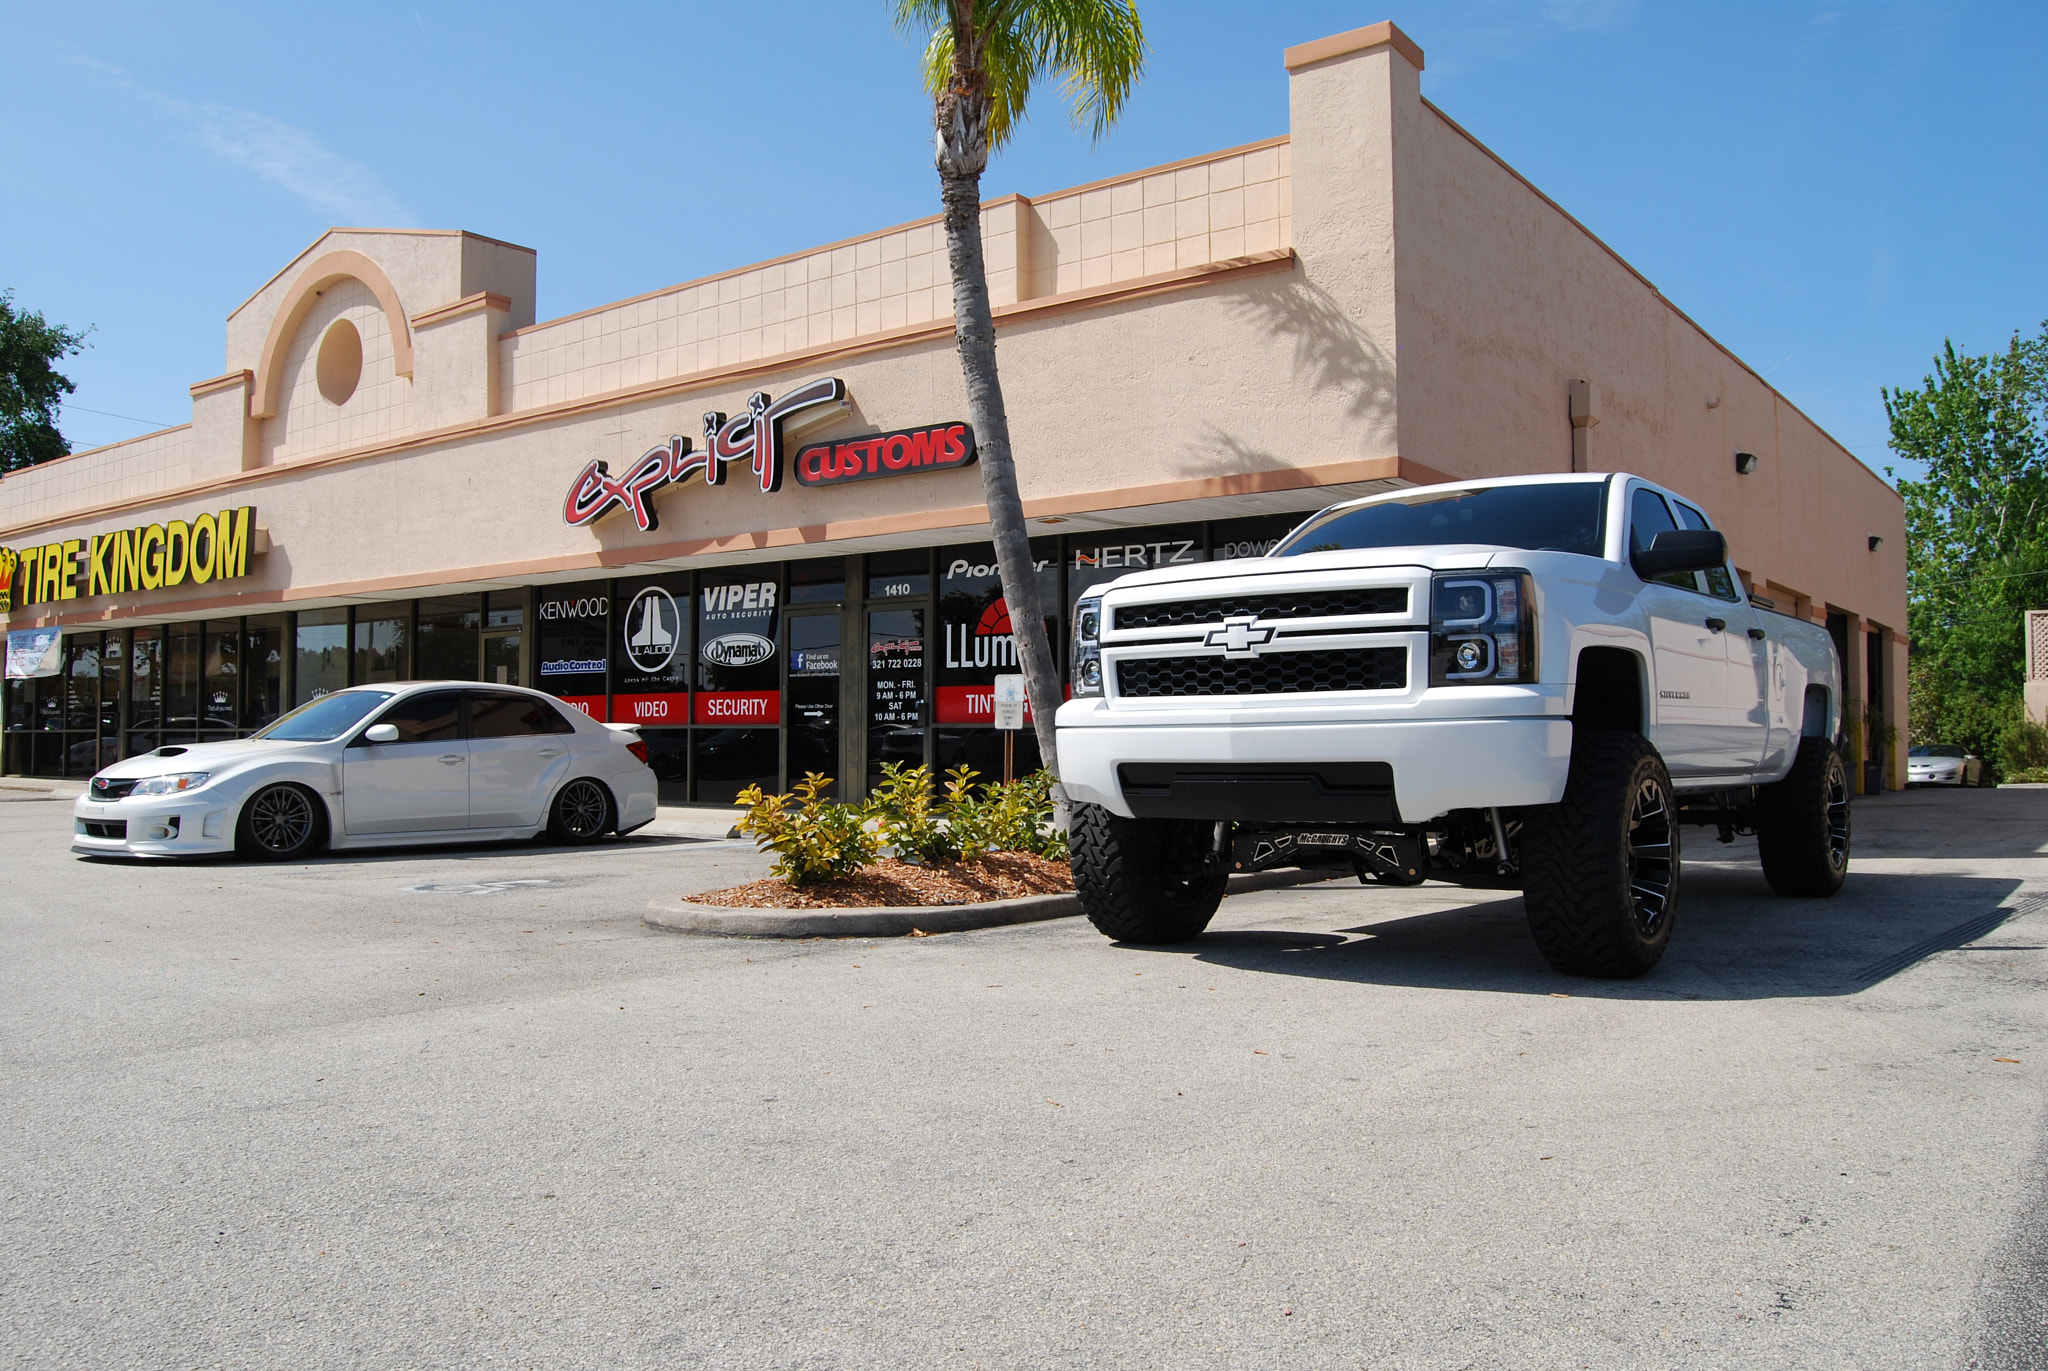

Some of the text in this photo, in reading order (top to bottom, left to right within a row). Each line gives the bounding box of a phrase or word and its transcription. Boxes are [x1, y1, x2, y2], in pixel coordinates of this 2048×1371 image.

[800, 425, 966, 481] CUSTOMS
[20, 506, 254, 606] TIRE KINGDOM
[1075, 539, 1195, 570] HERTZ
[1224, 538, 1285, 560] powe
[947, 559, 1049, 580] Pionr
[703, 582, 777, 612] VIPER
[884, 583, 911, 597] 1410
[539, 597, 608, 621] KENWOOD
[705, 609, 774, 621] AUTO SECURITY
[631, 644, 672, 656] JL AUDIO
[715, 640, 763, 662] Dynamat
[946, 623, 1020, 669] LLum
[541, 659, 606, 675] AudioControl
[805, 659, 838, 670] Facebook
[872, 658, 922, 669] 321 722 0228
[877, 680, 896, 689] MON.
[901, 680, 916, 689] FRI.
[876, 691, 881, 700] 9
[882, 691, 893, 700] AM
[899, 691, 904, 700] 6
[905, 690, 916, 699] PM
[634, 700, 668, 717] VIDEO
[707, 699, 768, 716] SECURITY
[888, 701, 903, 710] SAT
[874, 712, 883, 721] 10
[884, 712, 896, 720] AM
[901, 712, 906, 720] 6
[907, 711, 919, 720] PM
[1298, 833, 1349, 845] McGAUGHYS
